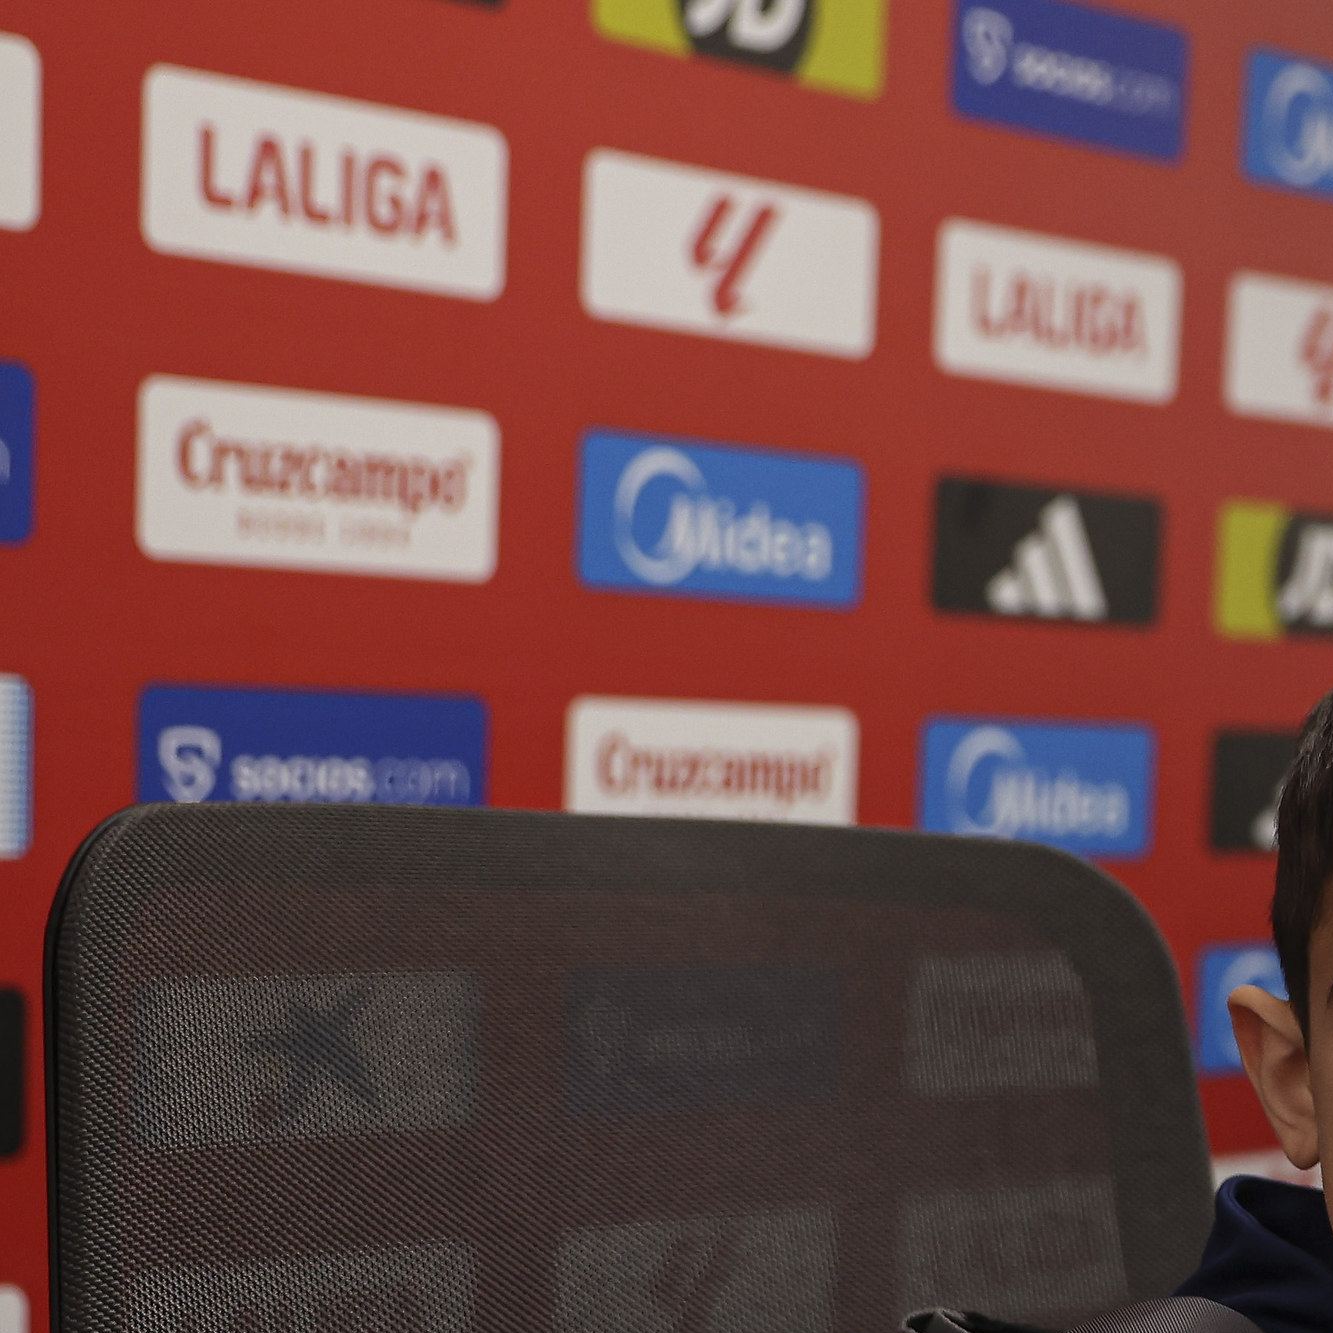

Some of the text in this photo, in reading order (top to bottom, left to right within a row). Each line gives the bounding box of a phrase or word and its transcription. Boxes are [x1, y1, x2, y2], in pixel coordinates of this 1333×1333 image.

[198, 122, 457, 249] LALIGA
[970, 260, 1149, 363] LALIGA
[174, 416, 468, 517] Cruzcampo
[671, 494, 833, 581] Midea
[228, 750, 472, 799] socios.com
[985, 762, 1131, 839] Midea
